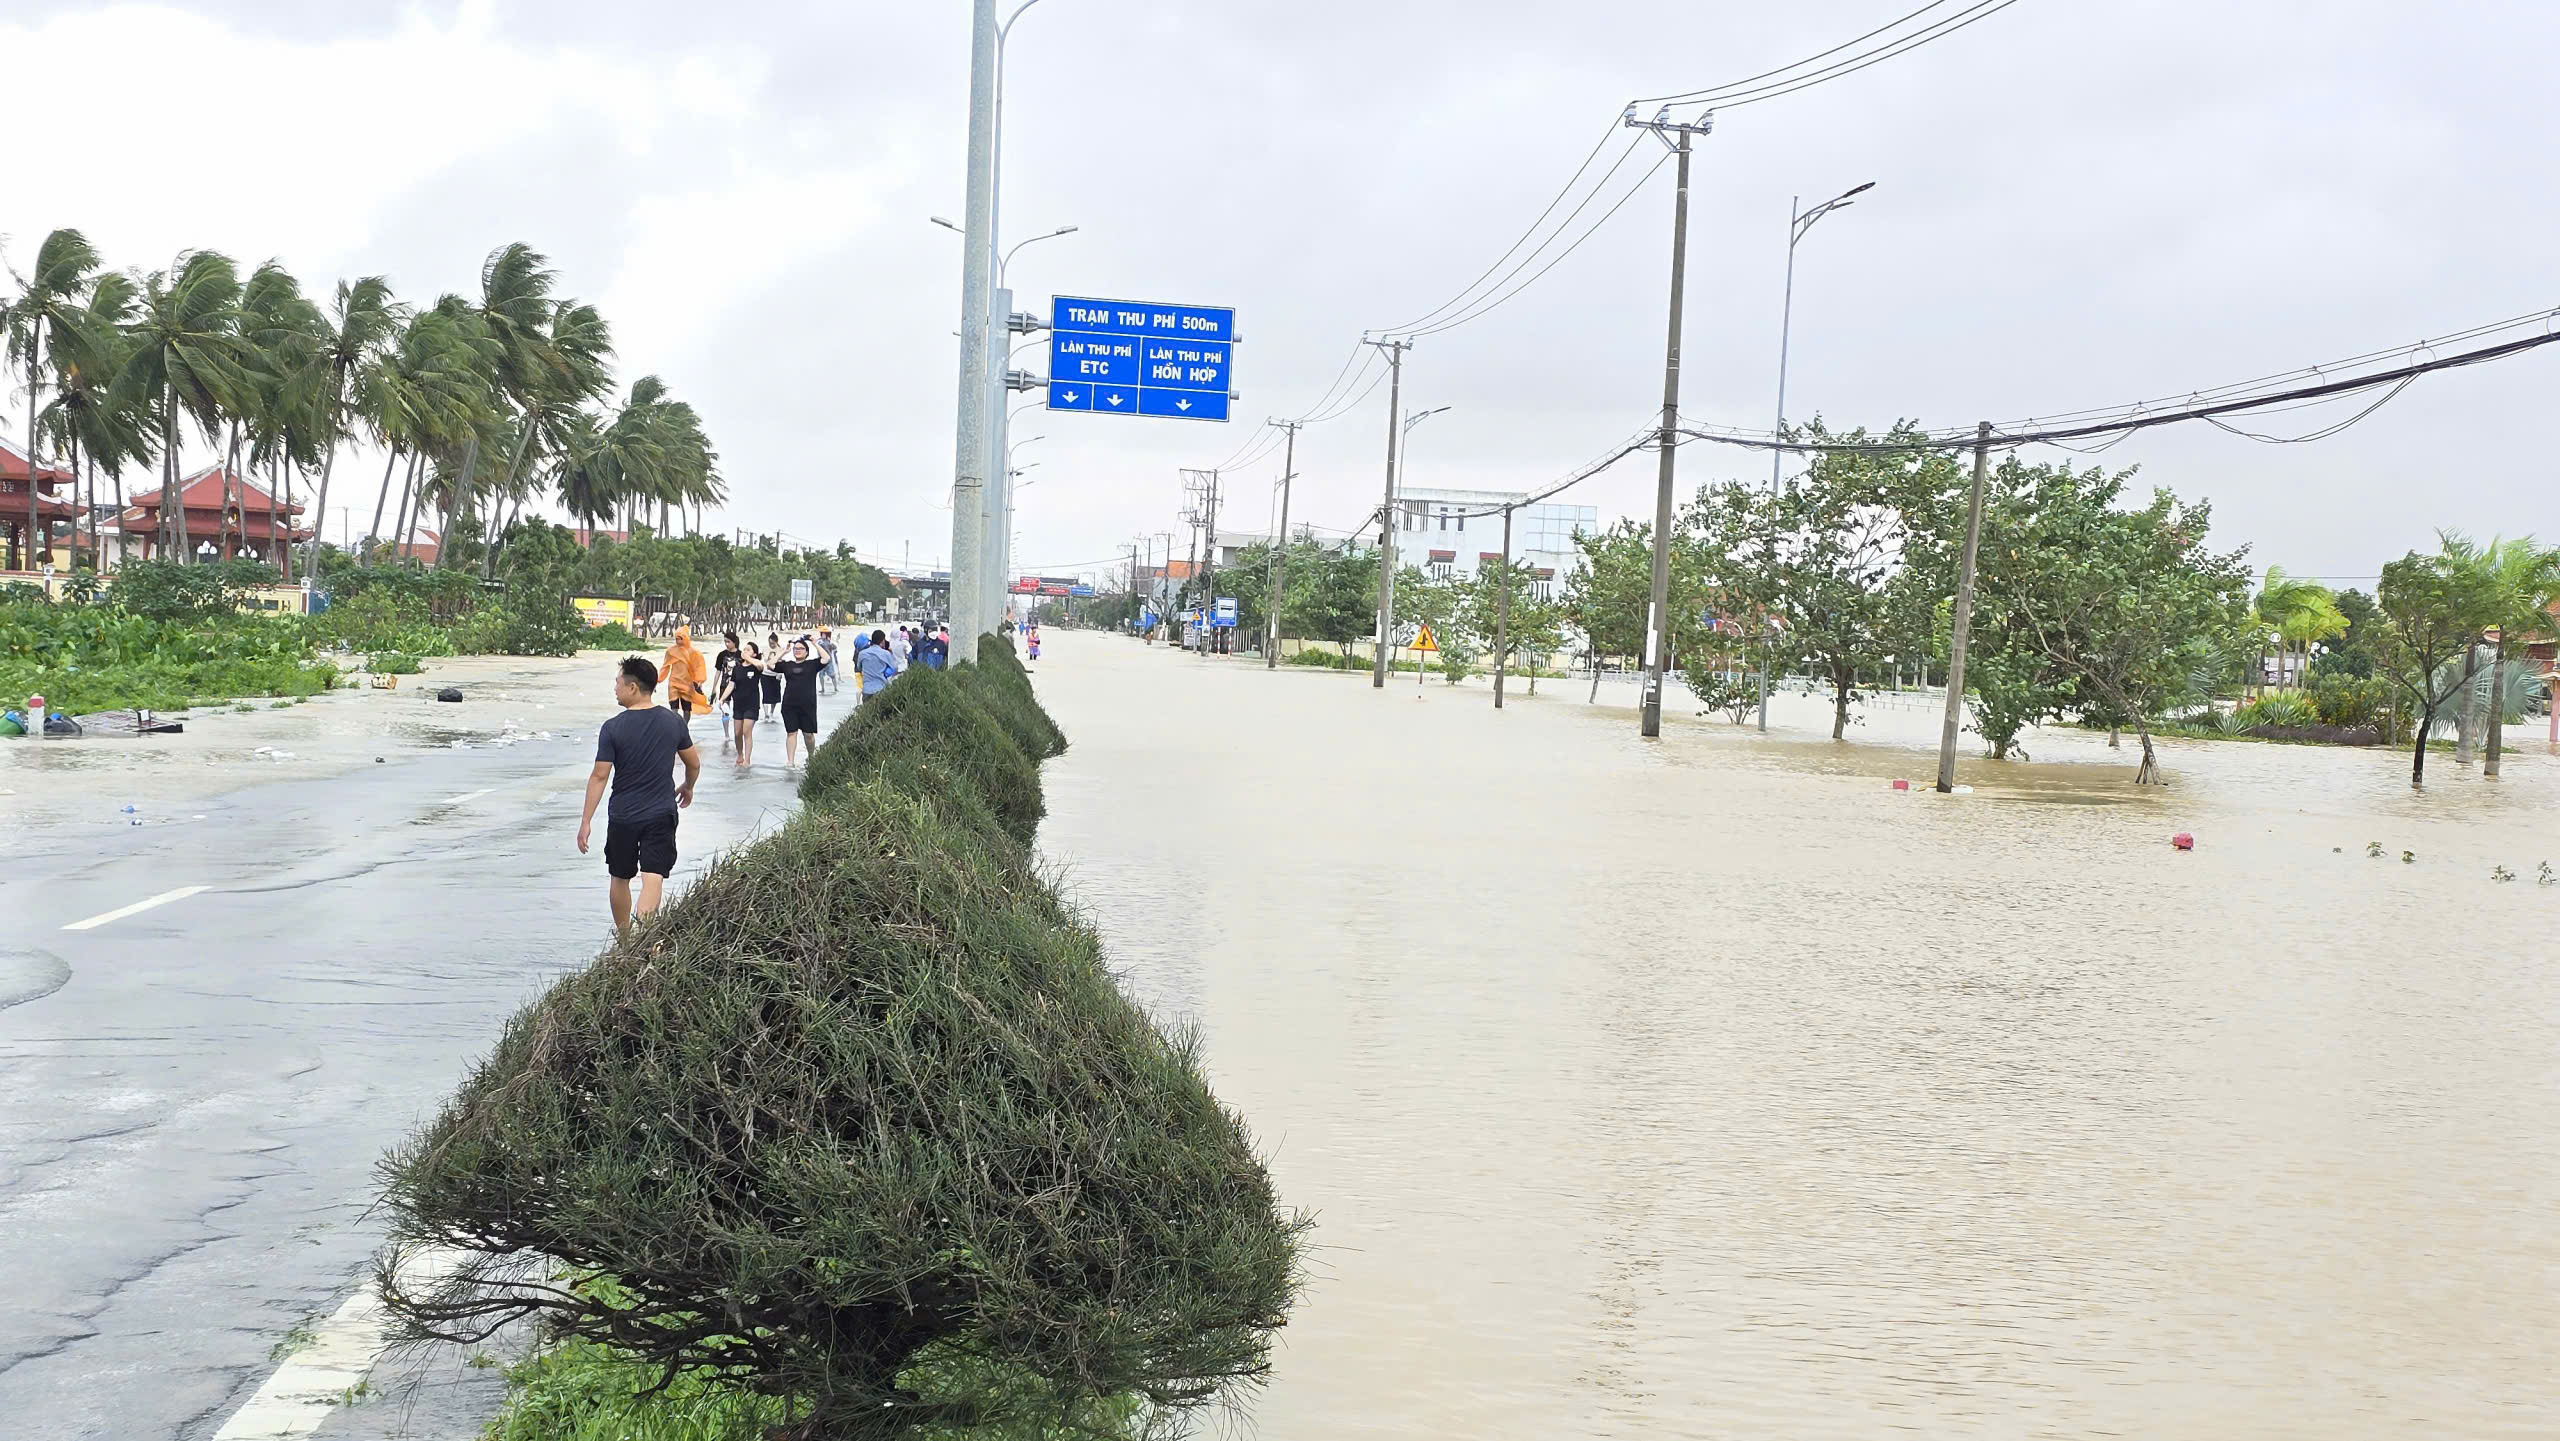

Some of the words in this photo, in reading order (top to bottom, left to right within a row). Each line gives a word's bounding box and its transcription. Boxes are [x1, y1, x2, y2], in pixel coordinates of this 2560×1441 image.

[1068, 307, 1109, 327] TRẠM
[1117, 311, 1146, 326] THU
[1153, 312, 1176, 329] PHÍ
[1182, 316, 1218, 332] 500m
[1060, 340, 1084, 354] LÀN
[1087, 343, 1111, 356] THU
[1113, 344, 1132, 357] PHÍ
[1149, 346, 1173, 361] LÀN
[1177, 350, 1200, 362] THU
[1203, 351, 1222, 364] PHÍ
[1080, 360, 1110, 375] ETC
[1152, 362, 1182, 380] HỖN
[1189, 366, 1217, 385] HỢP
